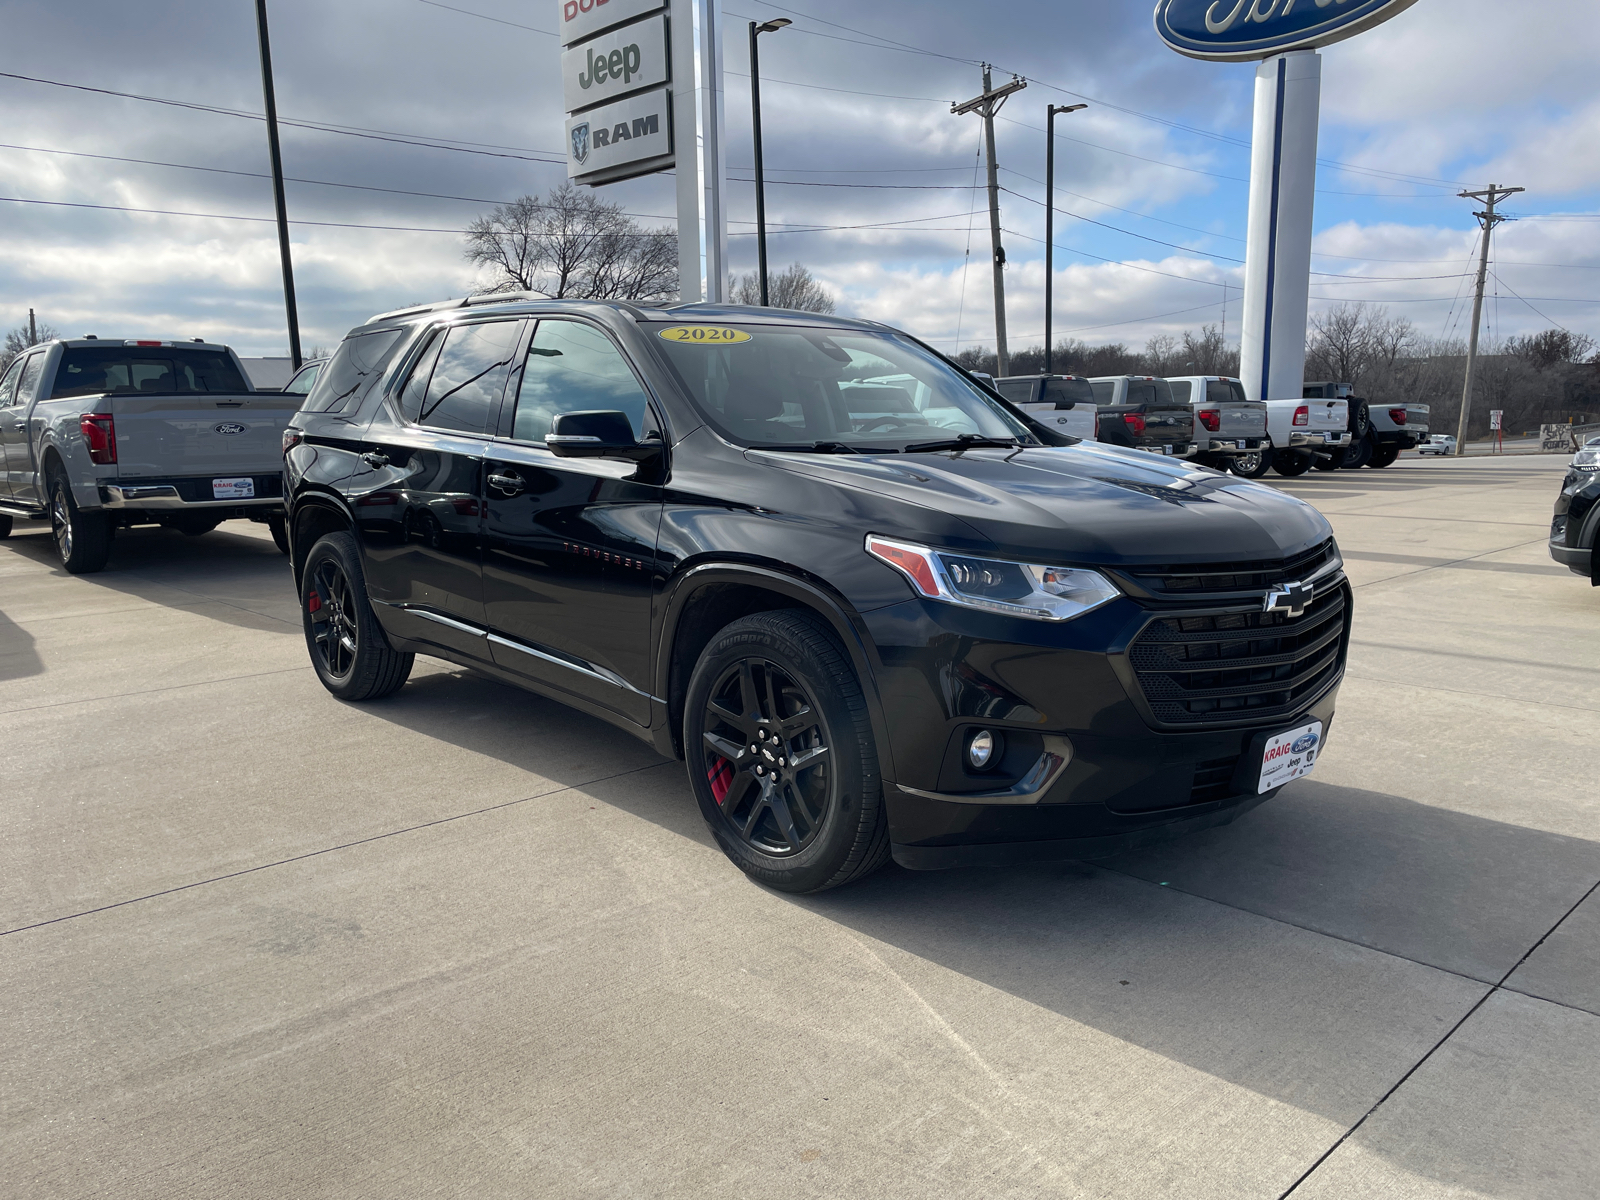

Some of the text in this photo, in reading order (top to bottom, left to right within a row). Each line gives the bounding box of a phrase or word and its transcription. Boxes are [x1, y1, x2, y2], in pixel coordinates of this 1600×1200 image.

[578, 43, 641, 90] Jeep
[592, 113, 659, 150] RAM
[676, 328, 736, 340] 2020
[220, 425, 240, 433] Ford
[563, 542, 642, 570] TRAVERSE
[1263, 742, 1291, 763] KRAIG
[1287, 757, 1301, 768] Jeep
